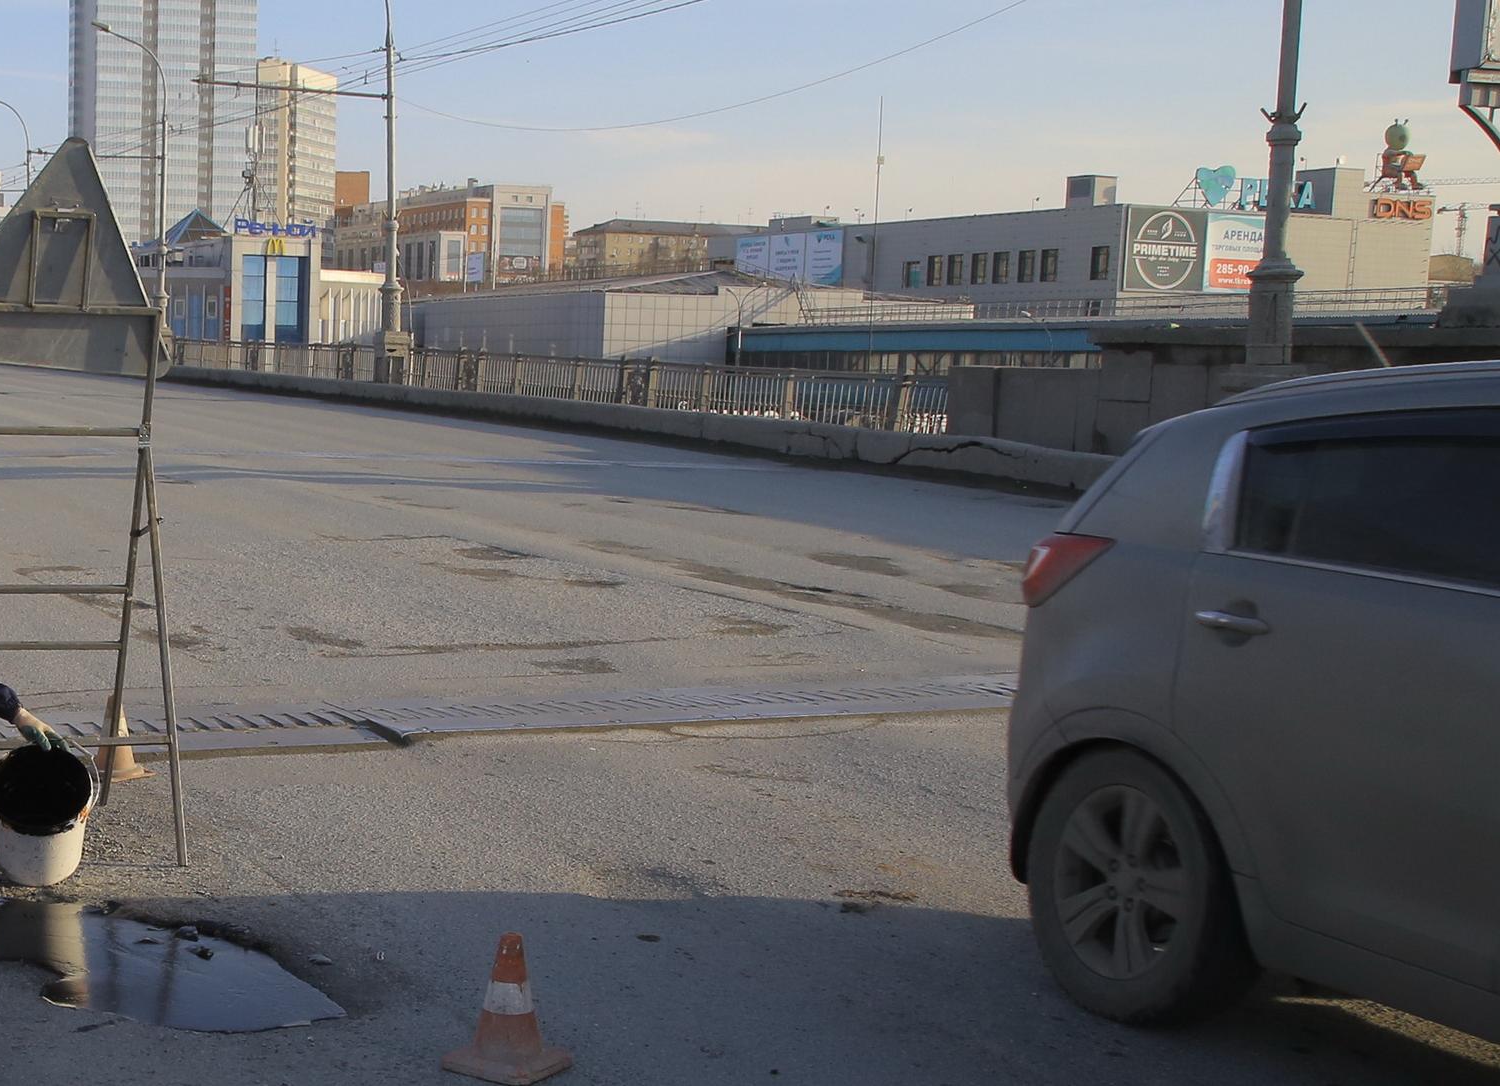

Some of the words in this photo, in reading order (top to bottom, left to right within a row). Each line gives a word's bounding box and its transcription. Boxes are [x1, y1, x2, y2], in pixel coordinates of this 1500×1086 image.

[1374, 197, 1433, 220] DNS
[234, 217, 316, 238] Речной
[1223, 230, 1263, 243] АРЕНДА
[1132, 243, 1197, 257] PRIMETIME
[1216, 263, 1257, 275] 285-90-
